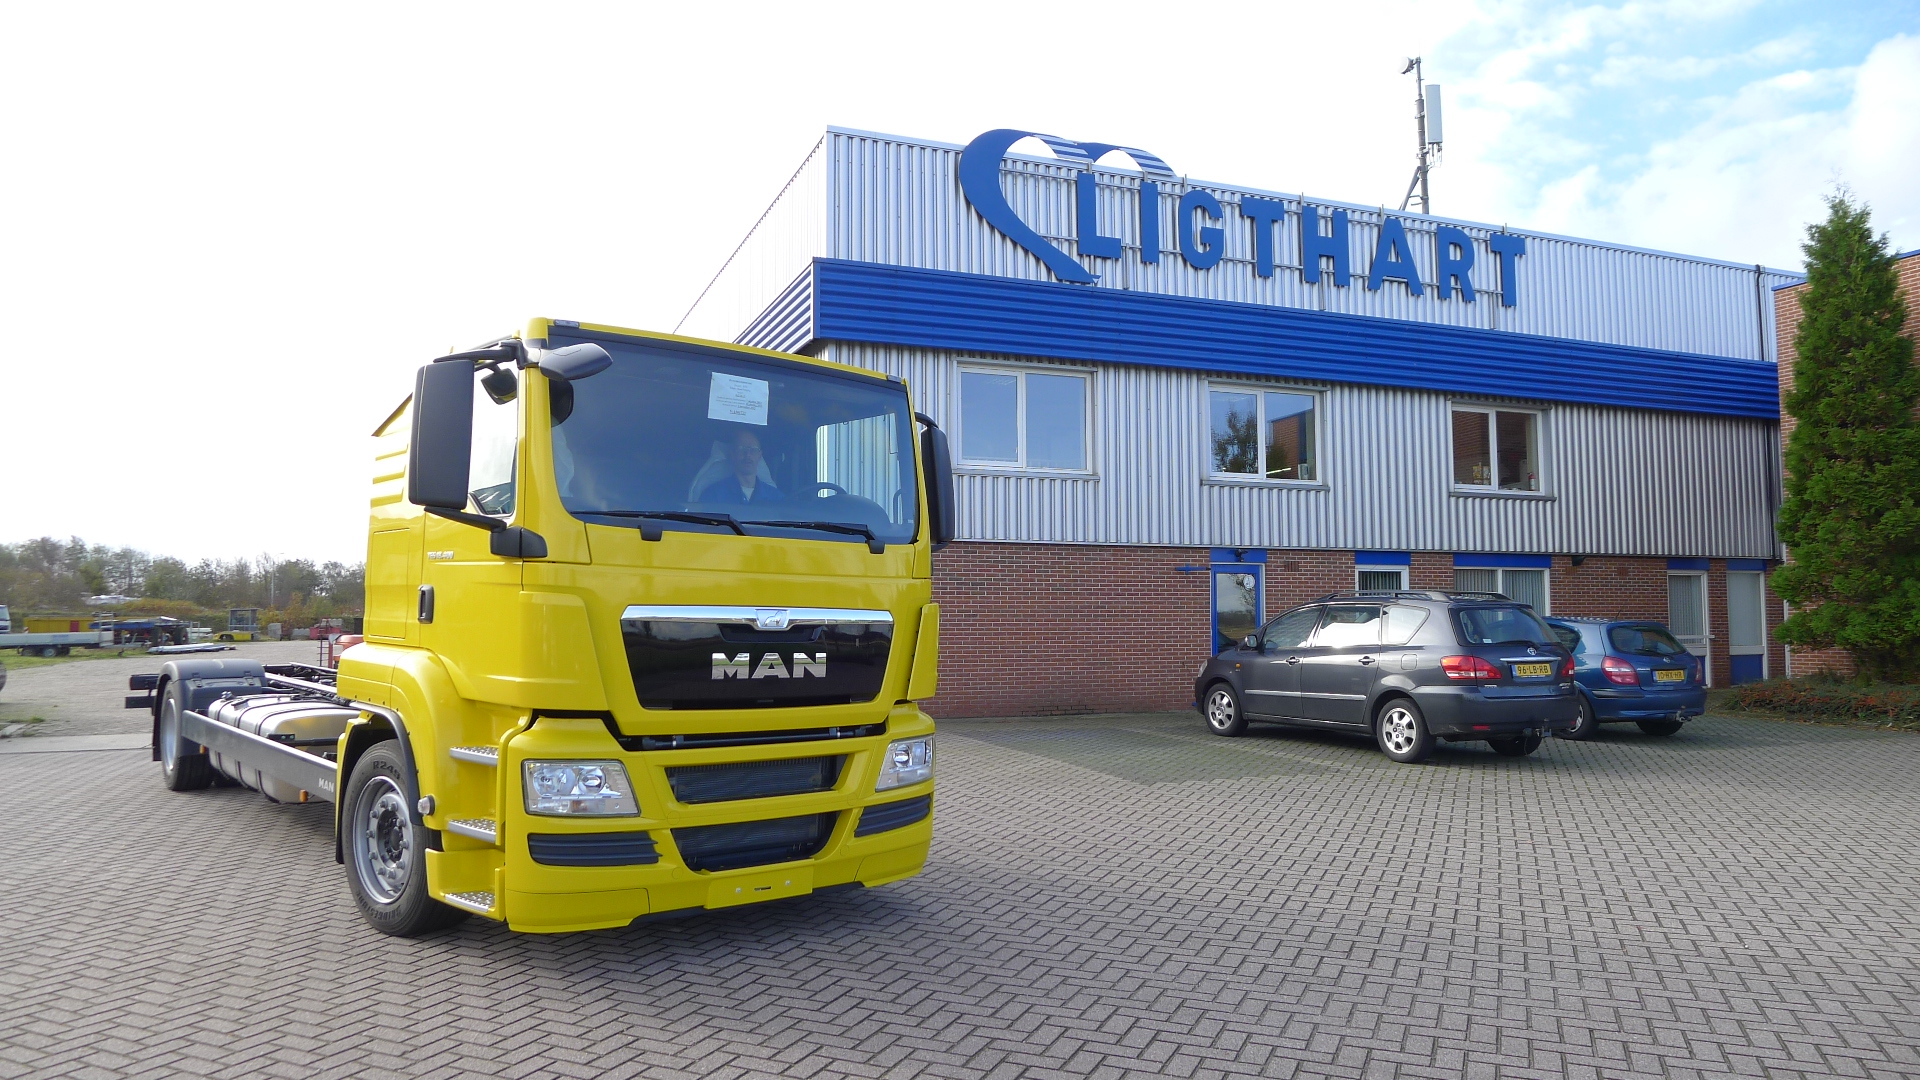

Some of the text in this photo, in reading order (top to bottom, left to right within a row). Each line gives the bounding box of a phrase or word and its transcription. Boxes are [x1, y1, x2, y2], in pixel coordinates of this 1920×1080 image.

[1077, 173, 1525, 307] LIGTHART
[711, 652, 827, 680] MAN
[318, 778, 335, 793] MAN
